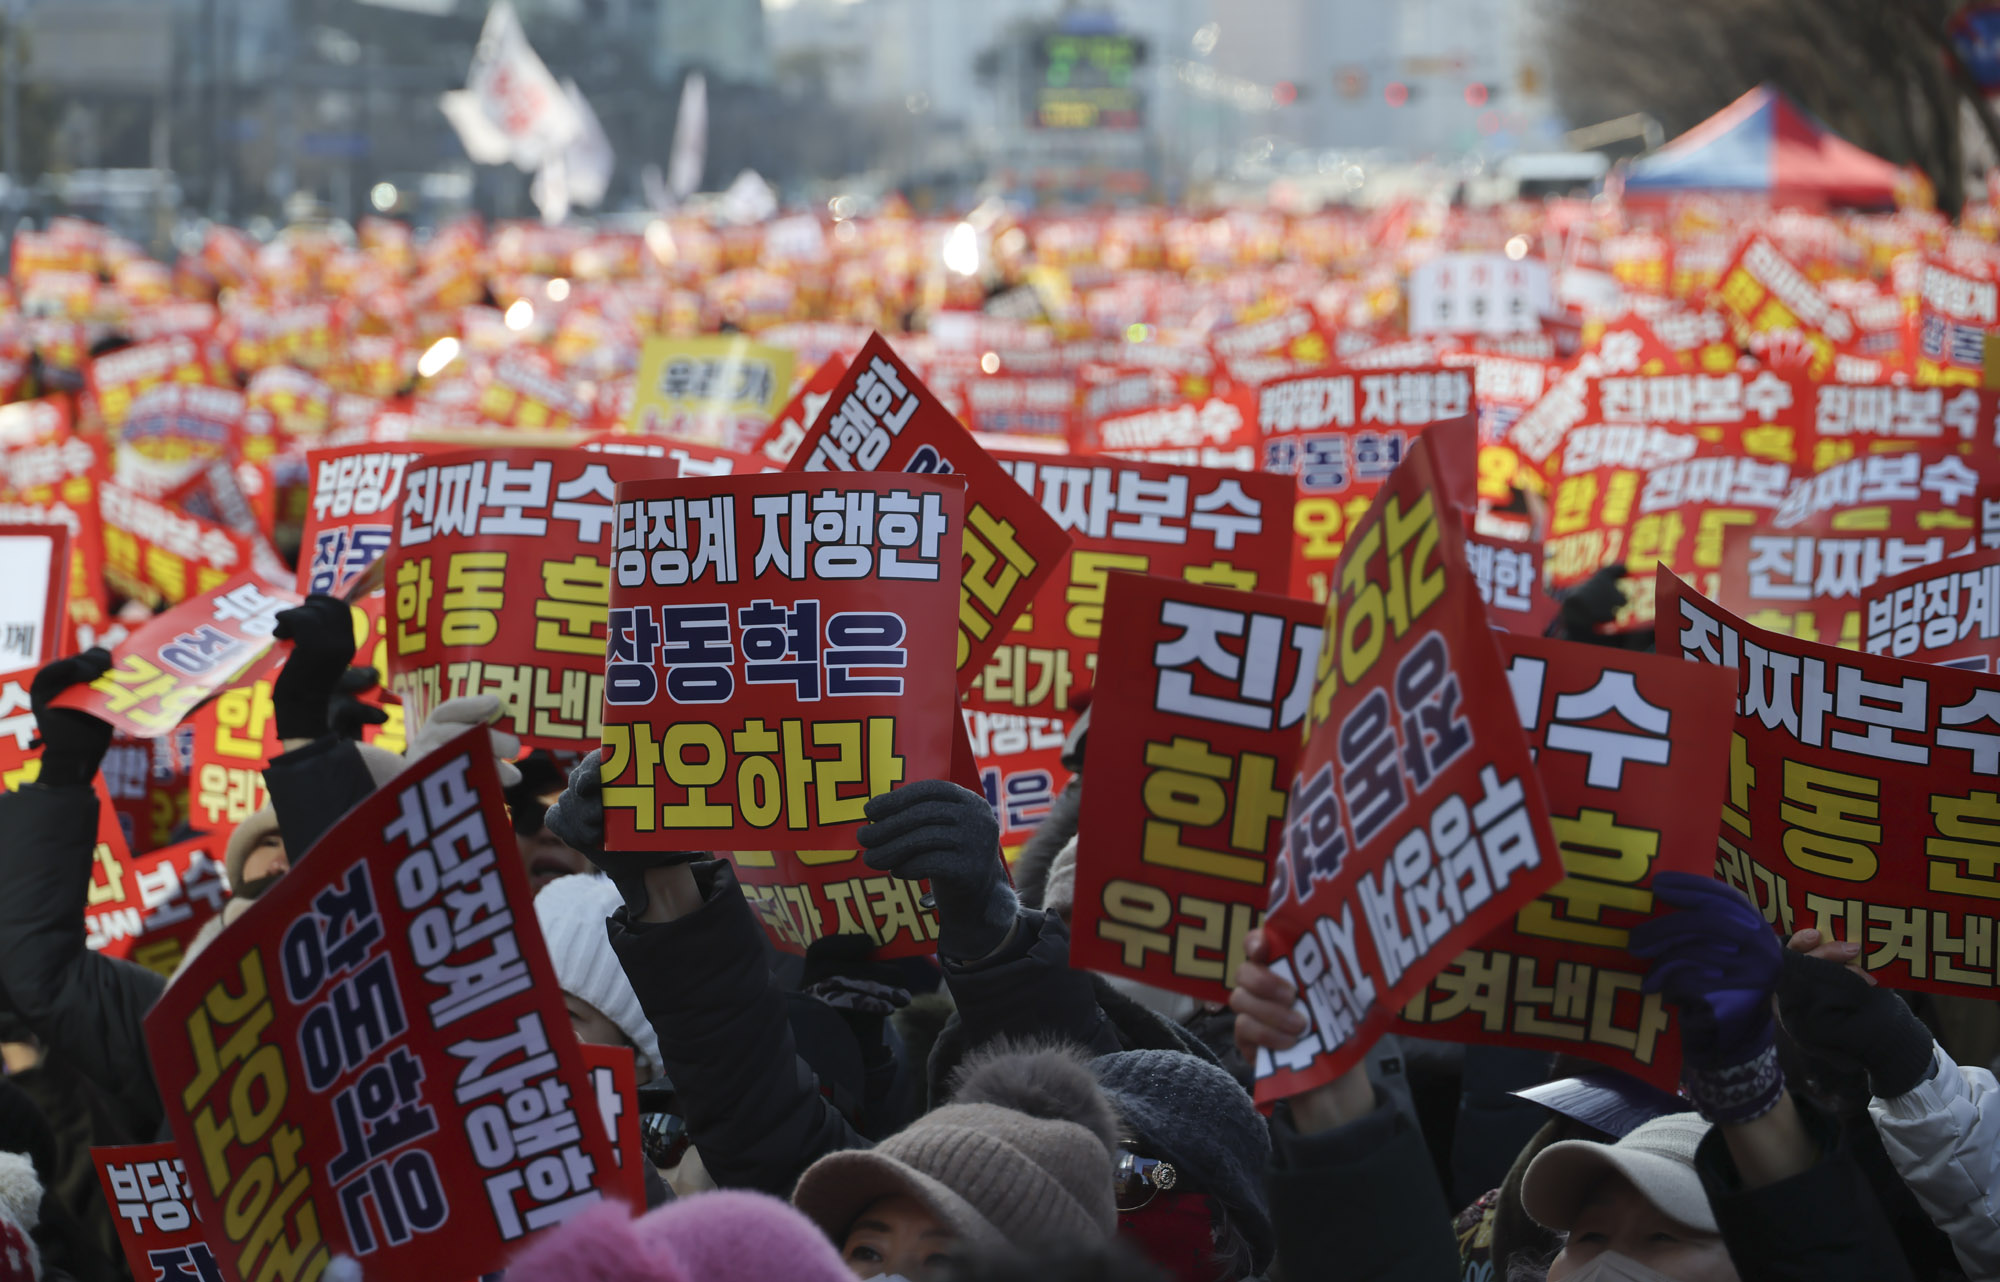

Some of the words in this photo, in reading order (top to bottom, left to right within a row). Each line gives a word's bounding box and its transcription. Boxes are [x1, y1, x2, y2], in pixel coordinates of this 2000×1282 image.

[399, 460, 614, 547] 진짜보수
[1263, 430, 1421, 494] 장동혁
[613, 495, 738, 587] 당징계
[752, 489, 948, 580] 자행한
[1748, 535, 1976, 600] 진짜보
[605, 599, 907, 706] 장동혁은
[1866, 563, 2000, 658] 부당징계
[448, 660, 604, 740] 지켜낸
[962, 644, 1073, 711] 리가
[199, 762, 272, 824] 우리
[600, 716, 905, 833] 각오하라
[382, 752, 535, 1031] 부당징계
[1356, 762, 1542, 989] 부당징계
[1715, 836, 1795, 936] 리가
[1807, 892, 2000, 988] 지켜낸
[1097, 877, 1266, 993] 우리
[278, 857, 450, 1259] 장동혁은
[446, 1009, 604, 1241] 자행한
[106, 1158, 203, 1235] 부당
